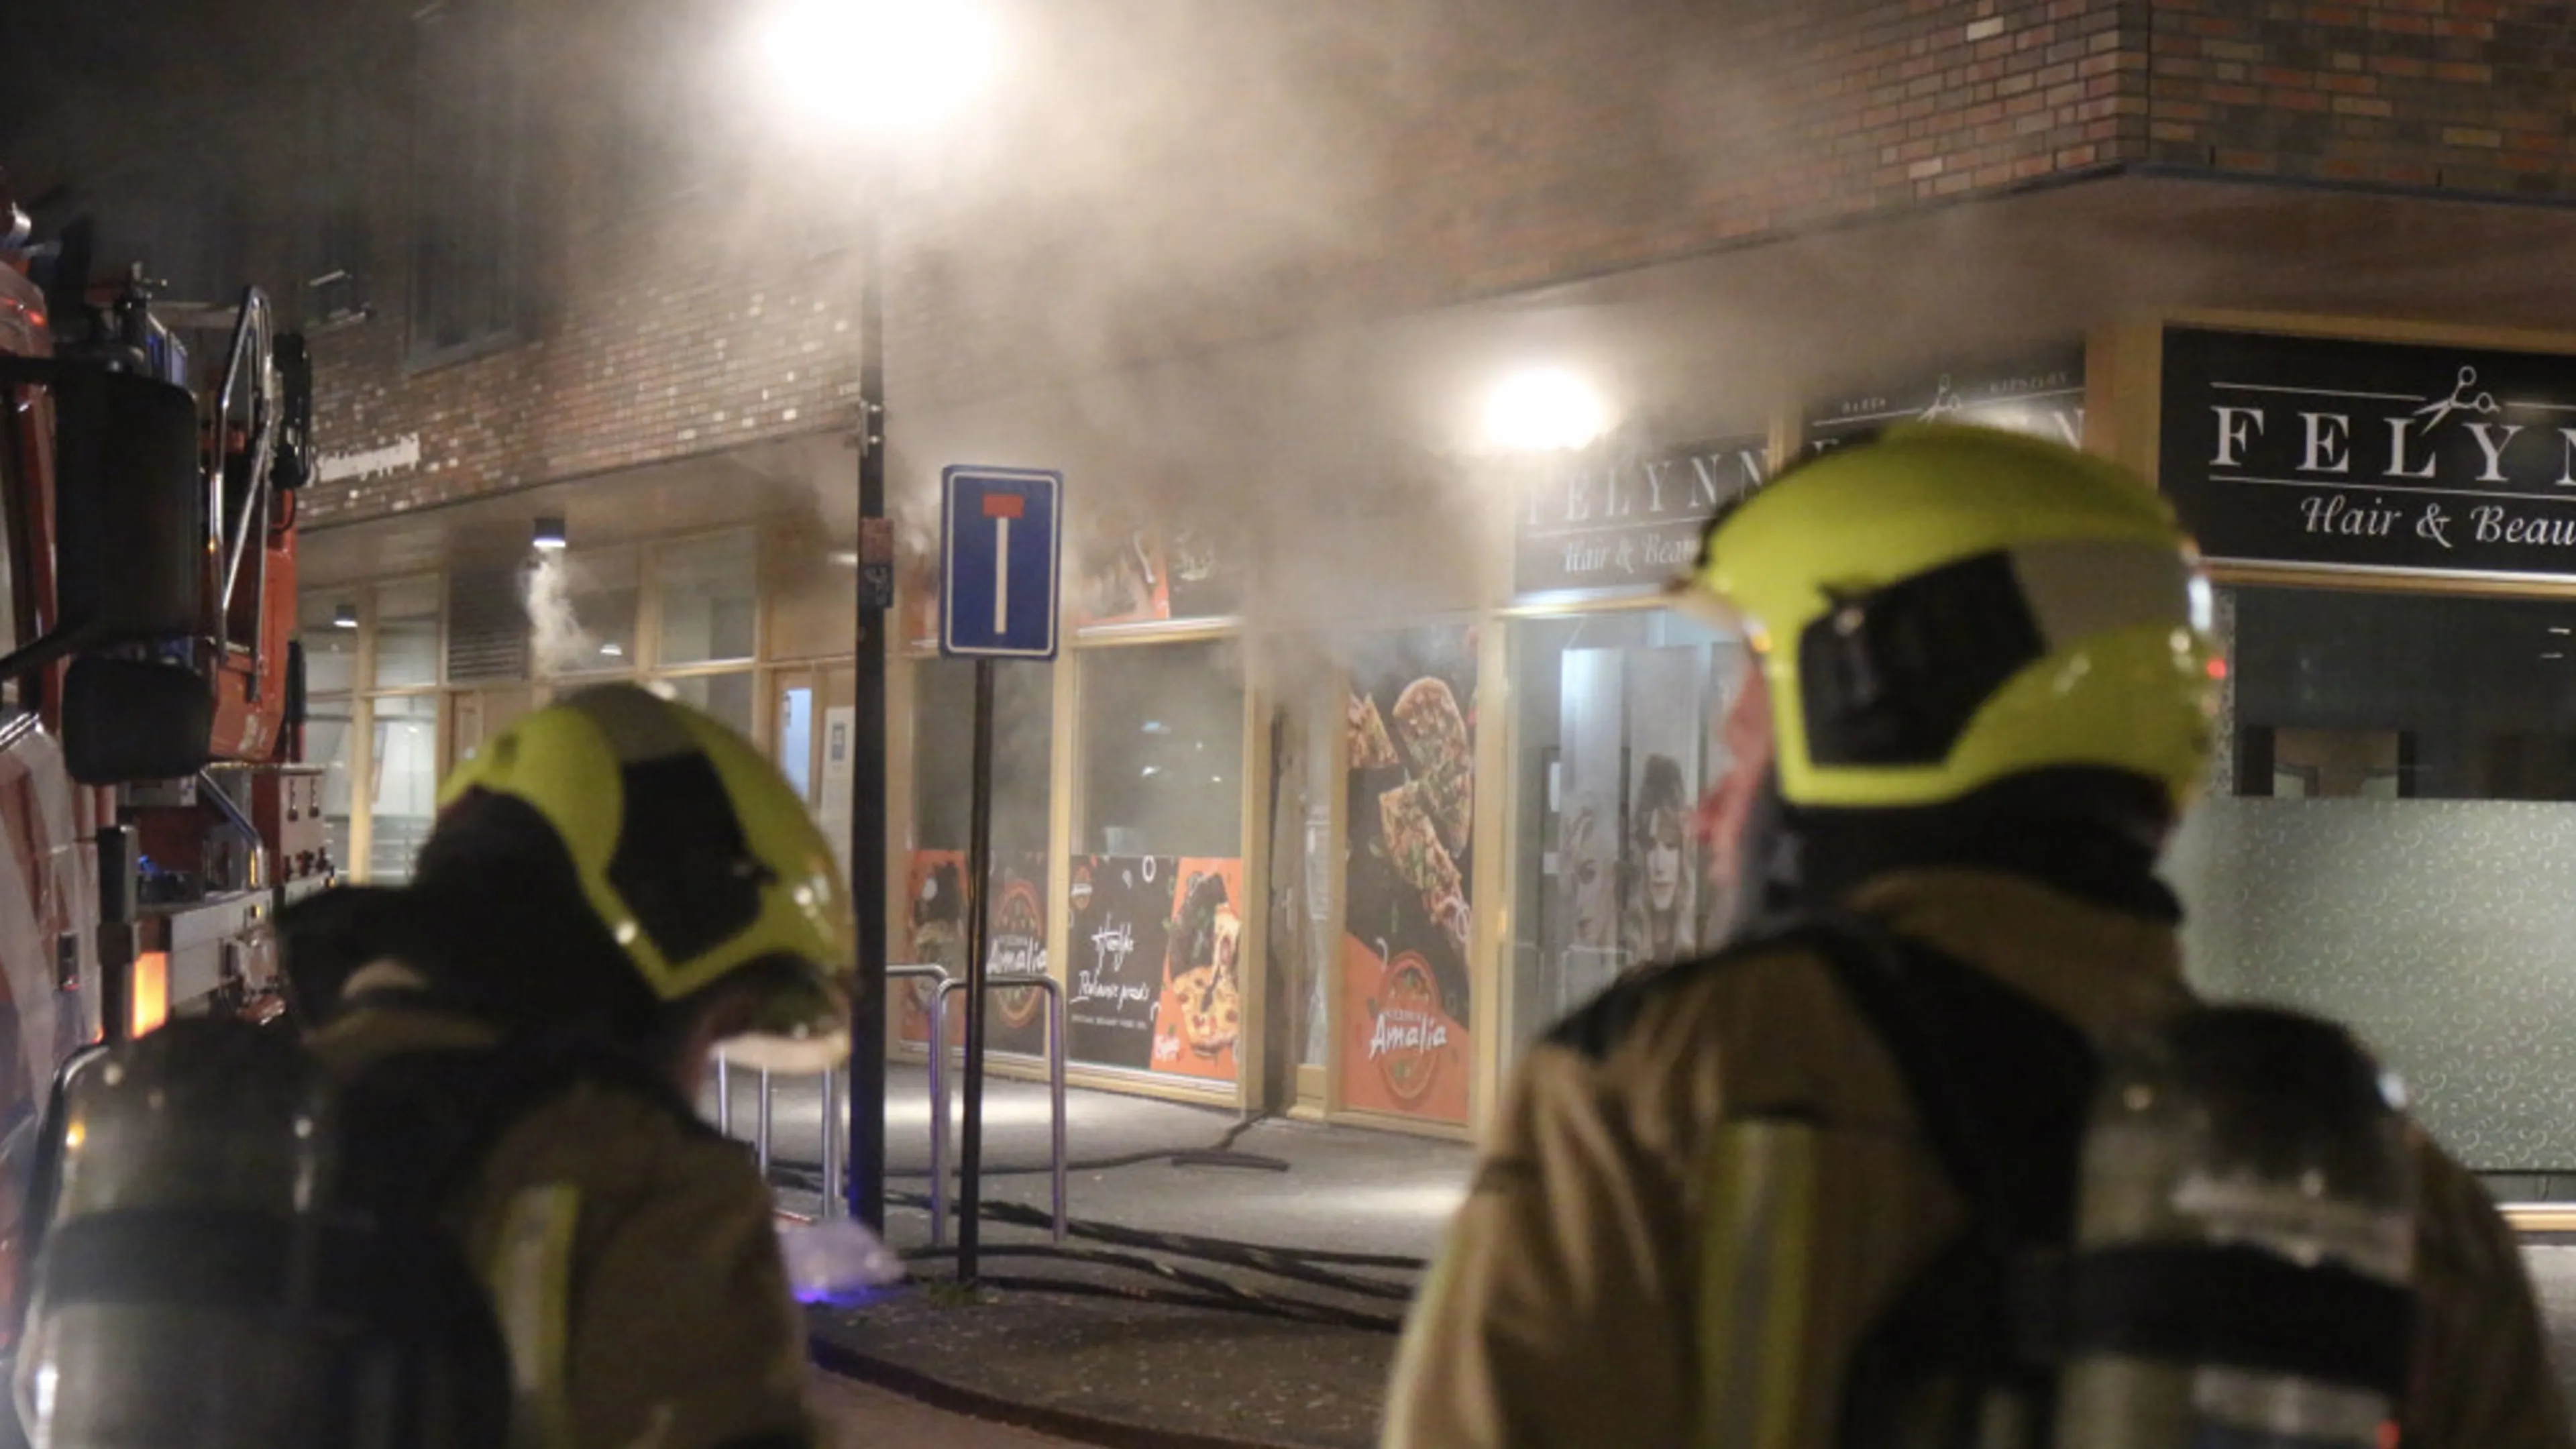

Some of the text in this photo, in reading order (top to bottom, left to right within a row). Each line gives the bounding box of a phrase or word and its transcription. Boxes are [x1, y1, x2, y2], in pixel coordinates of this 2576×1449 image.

[2300, 494, 2402, 535] Hair
[2416, 502, 2453, 548] &
[1564, 537, 1611, 574] Hair
[1368, 1012, 1447, 1061] Amalia
